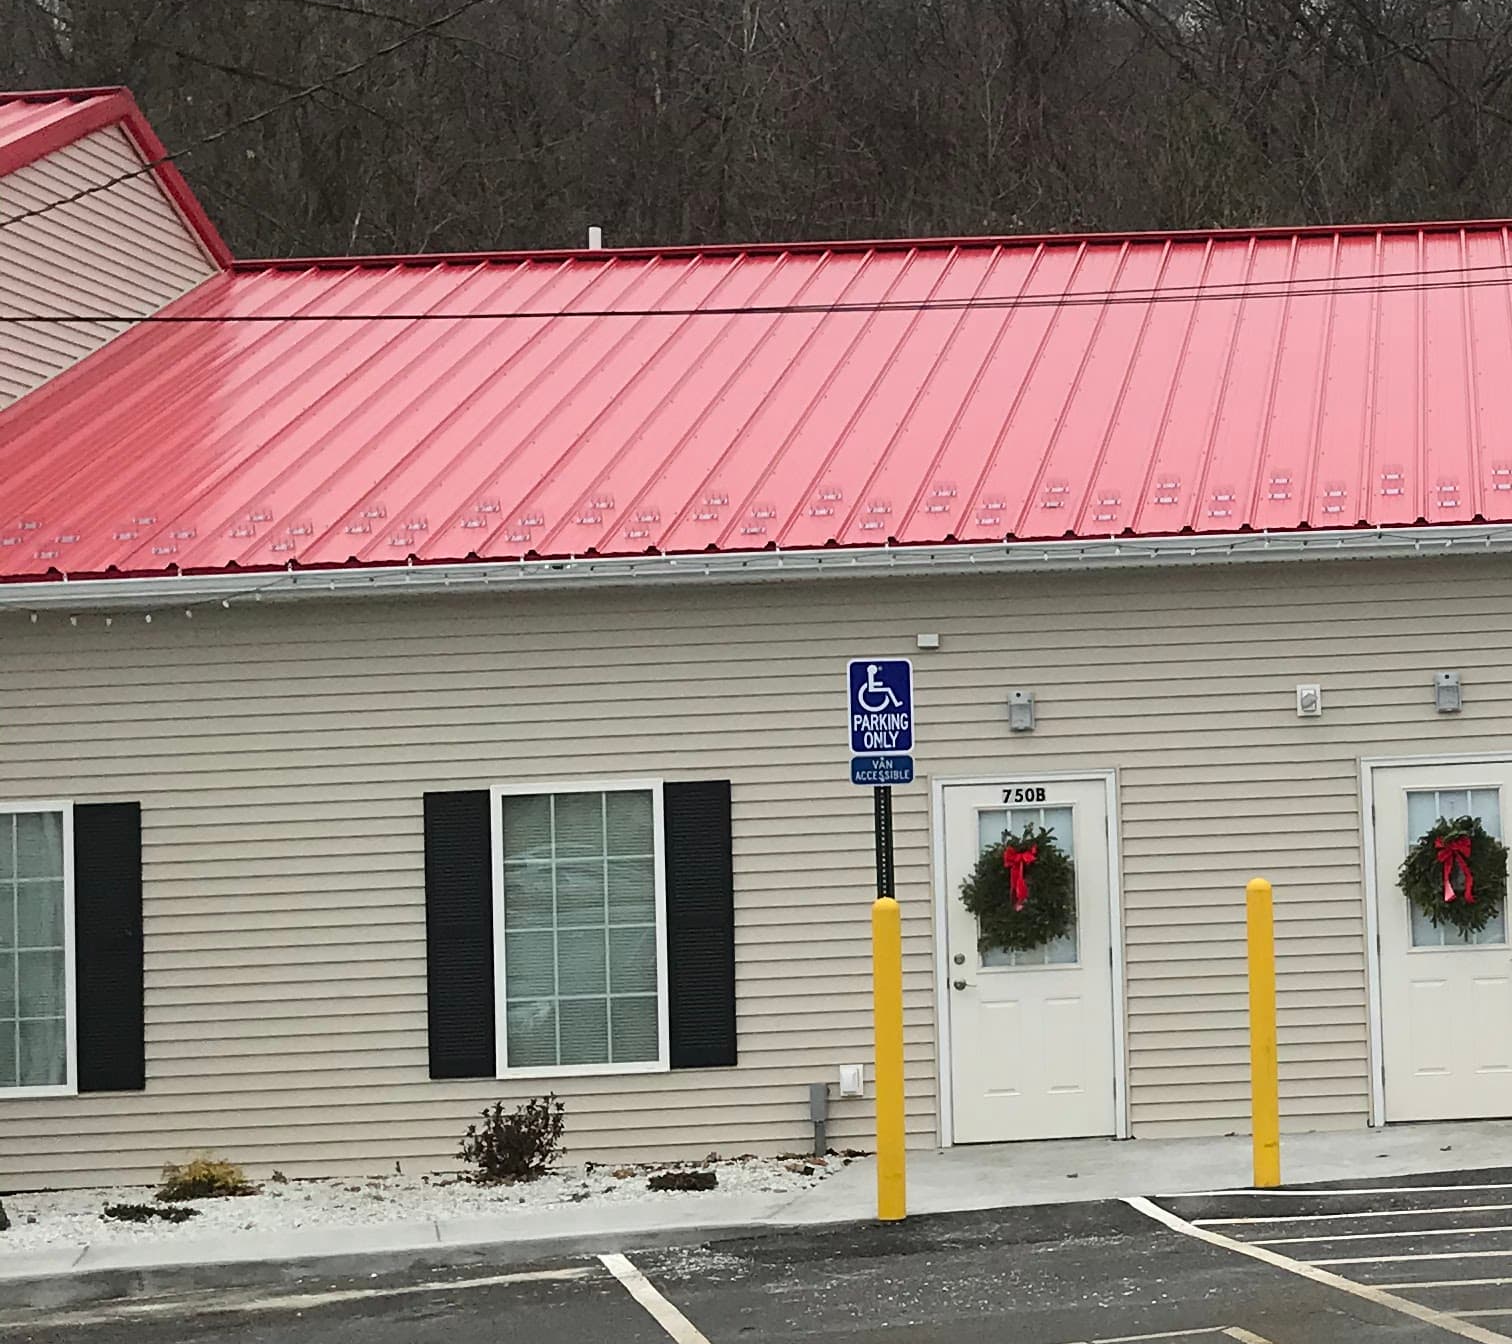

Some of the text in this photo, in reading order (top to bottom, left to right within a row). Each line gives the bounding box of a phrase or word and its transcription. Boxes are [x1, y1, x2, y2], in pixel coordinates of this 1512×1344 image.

[853, 713, 909, 731] PARKING
[863, 731, 899, 748] ONLY
[872, 759, 893, 769] VAN
[855, 769, 910, 781] ACCESSIBLE
[1002, 788, 1046, 804] 750B
